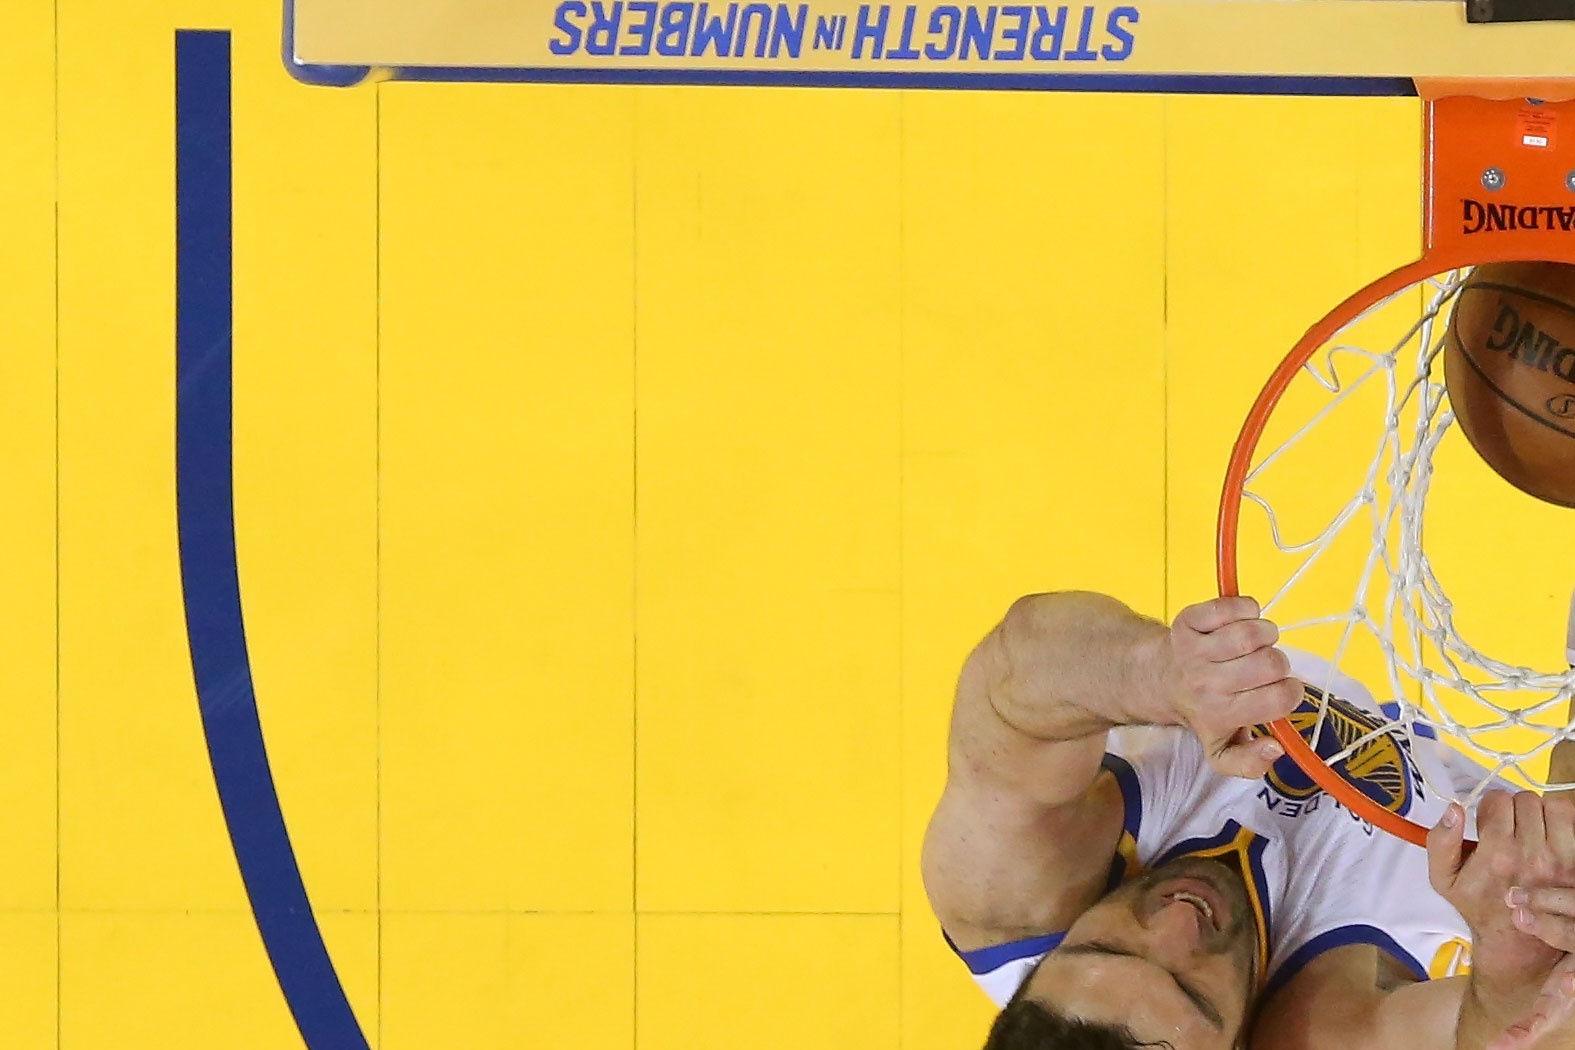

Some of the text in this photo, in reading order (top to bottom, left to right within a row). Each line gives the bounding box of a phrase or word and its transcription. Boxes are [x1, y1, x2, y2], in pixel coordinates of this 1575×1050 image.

[548, 0, 1140, 61] STRENGTH IN NUMBERS
